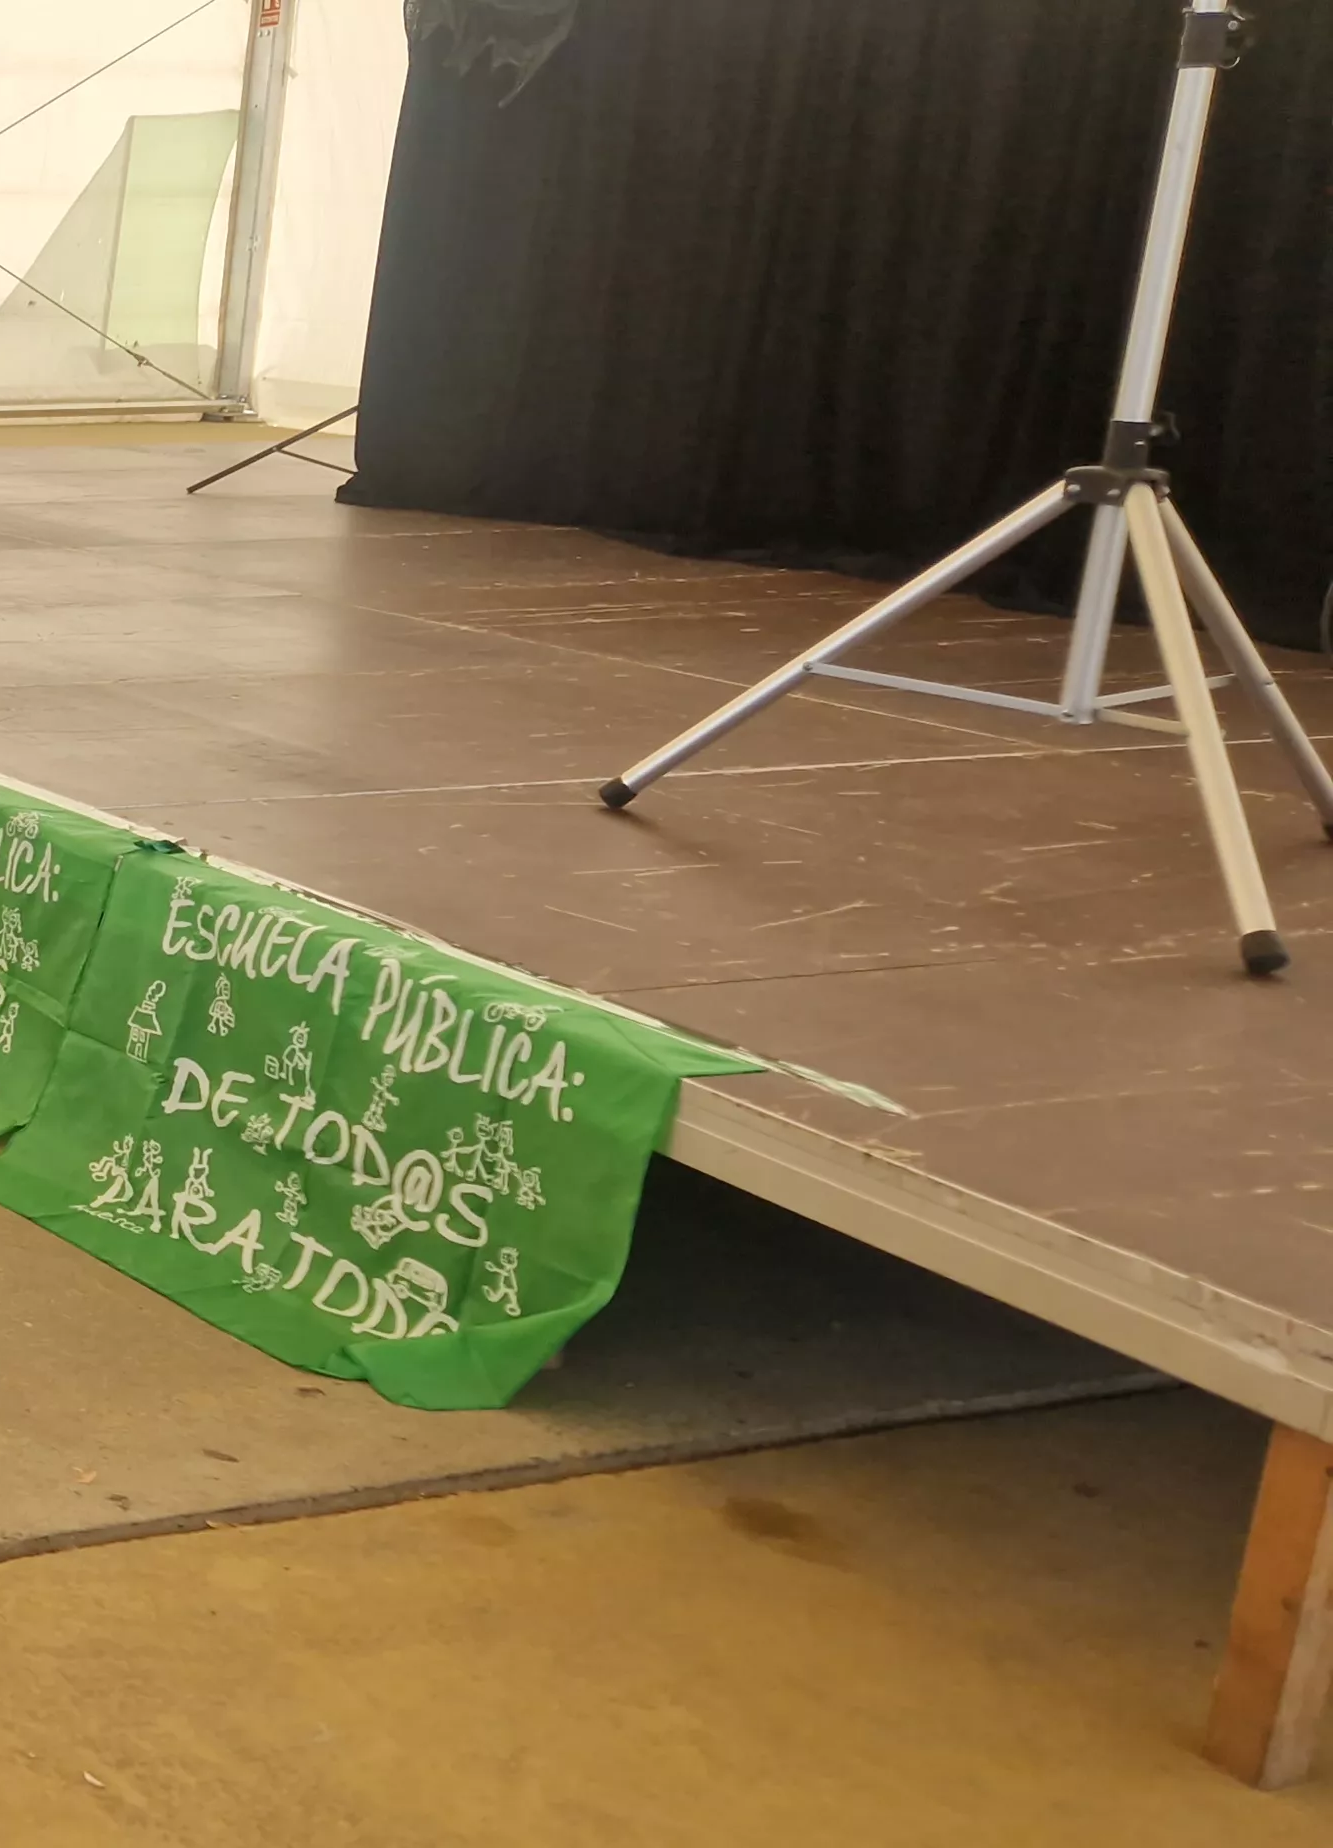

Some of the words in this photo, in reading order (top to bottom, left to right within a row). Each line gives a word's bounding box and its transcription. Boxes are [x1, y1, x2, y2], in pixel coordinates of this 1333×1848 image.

[162, 898, 367, 1017] ESCUELA
[360, 957, 586, 1123] PÚBLICA:
[161, 1056, 256, 1129] DE
[273, 1092, 493, 1248] TOD@S
[281, 1231, 461, 1341] TOD
